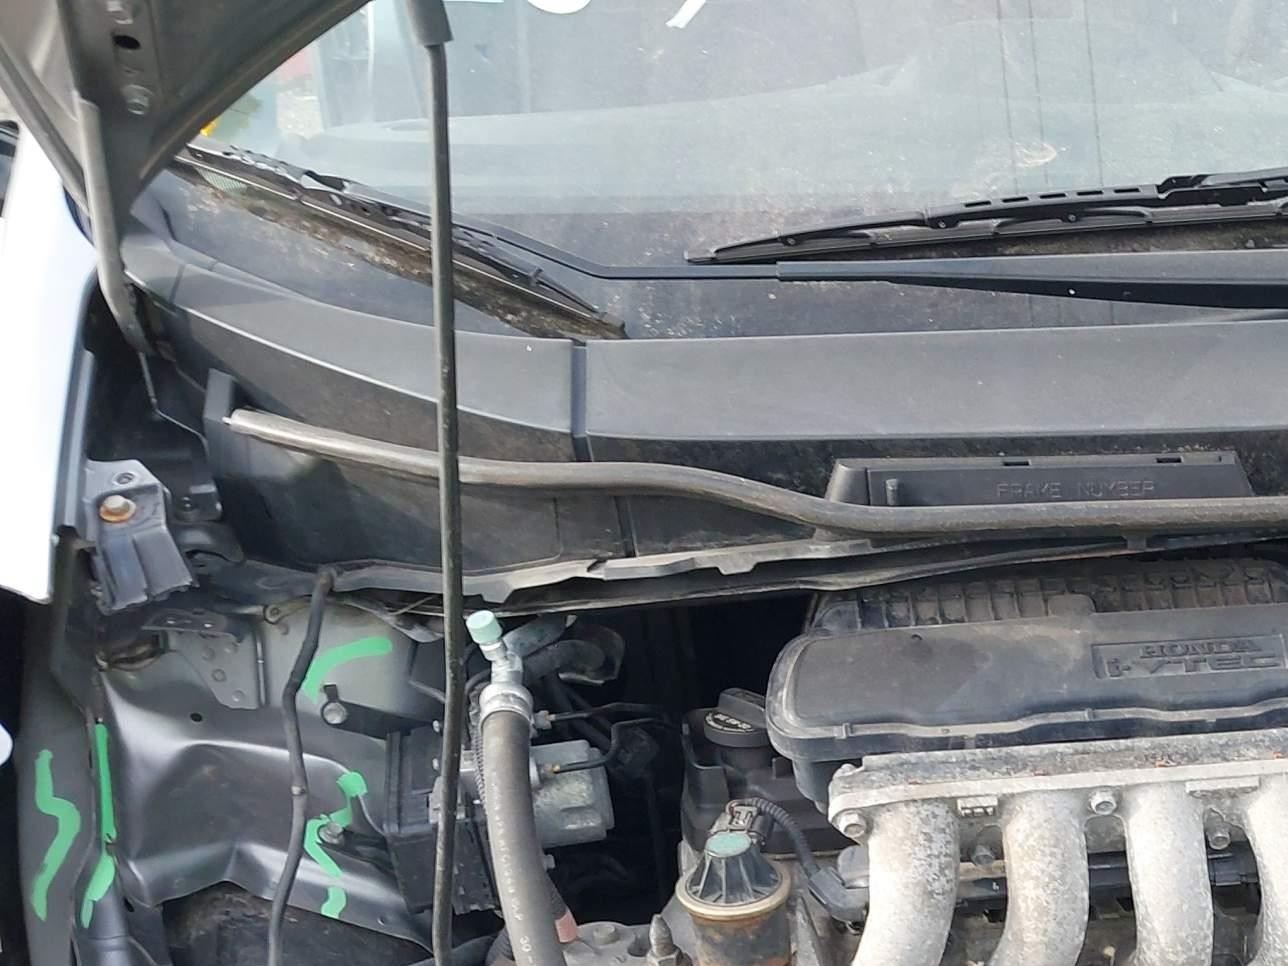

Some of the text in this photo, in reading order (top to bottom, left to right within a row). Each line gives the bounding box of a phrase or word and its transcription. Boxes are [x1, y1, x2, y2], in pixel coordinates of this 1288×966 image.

[996, 480, 1155, 499] FRAME NUMBER
[1140, 639, 1262, 659] HONDA
[1106, 654, 1280, 679] i-VTEC
